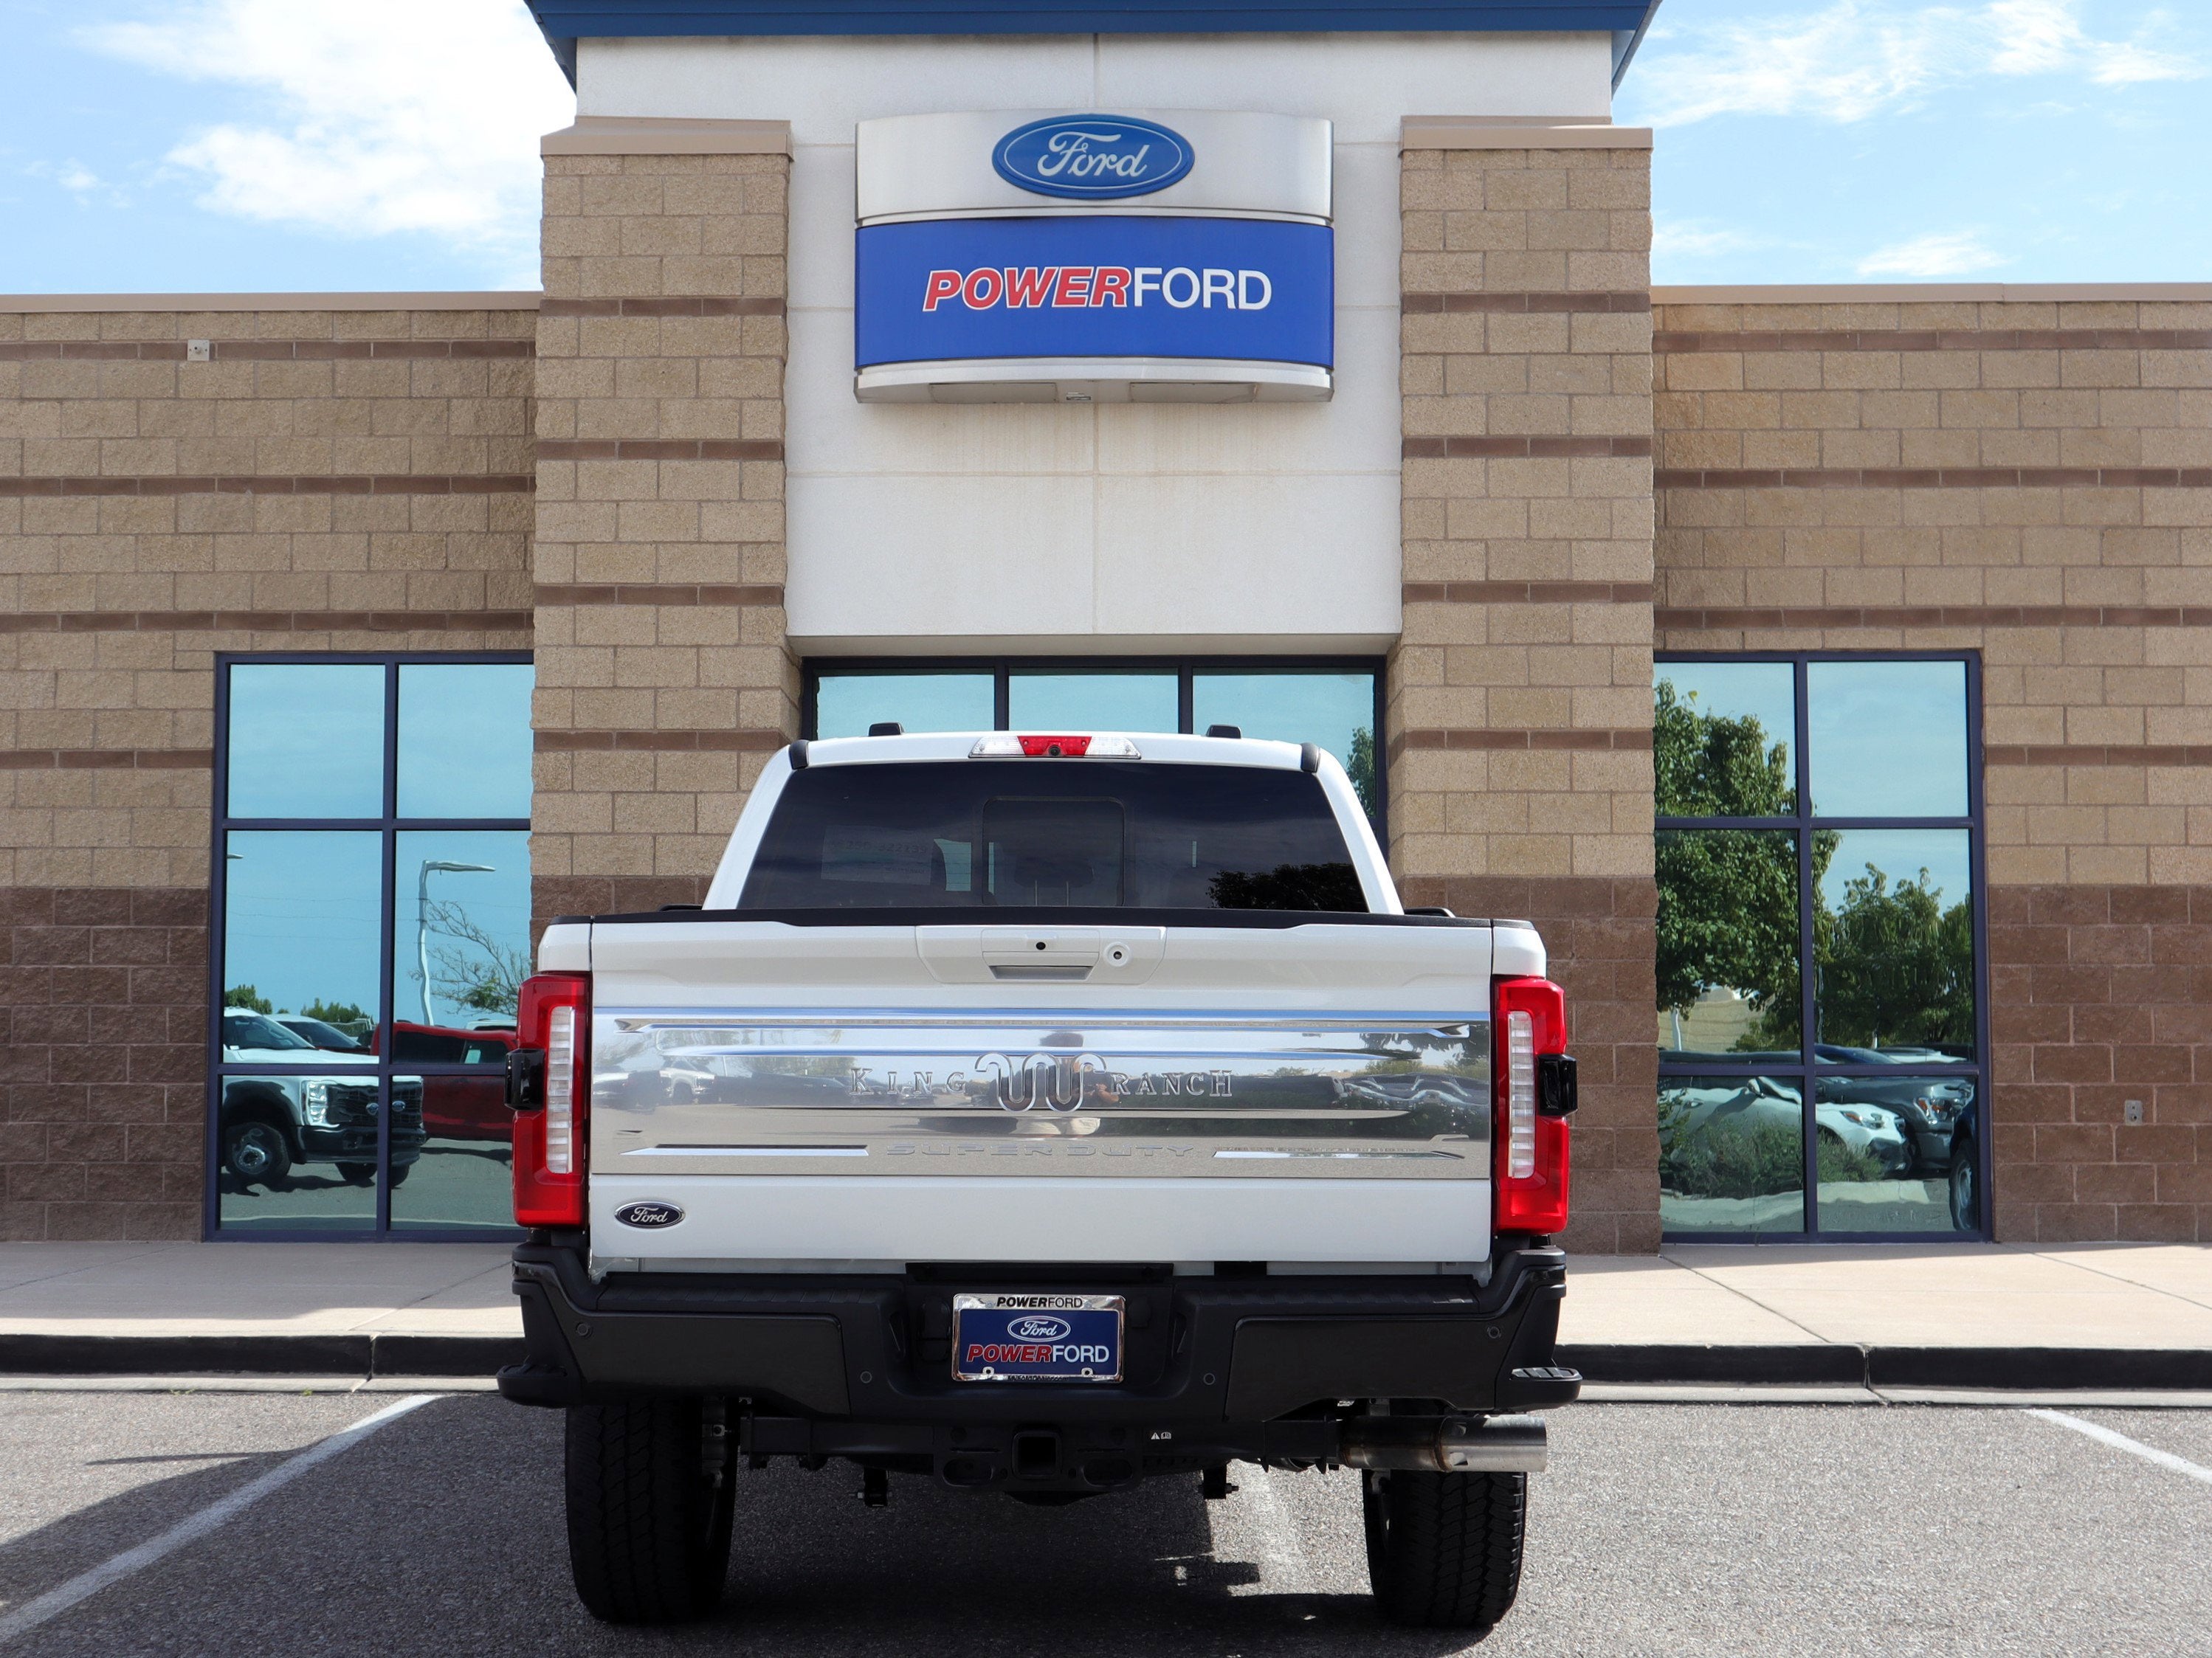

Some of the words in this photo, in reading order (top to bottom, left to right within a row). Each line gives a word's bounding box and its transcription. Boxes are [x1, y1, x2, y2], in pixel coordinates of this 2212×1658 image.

[1037, 131, 1151, 178] Ford
[923, 266, 1272, 312] POWERFORD
[848, 1067, 966, 1096] KING
[1110, 1069, 1233, 1097] RANCH
[886, 1143, 1052, 1156] SUPER
[1067, 1144, 1195, 1157] DUTY
[630, 1207, 669, 1224] Ford
[996, 1296, 1083, 1308] POWERFORD
[1020, 1320, 1058, 1336] Ford
[966, 1344, 1110, 1363] POWERFORD
